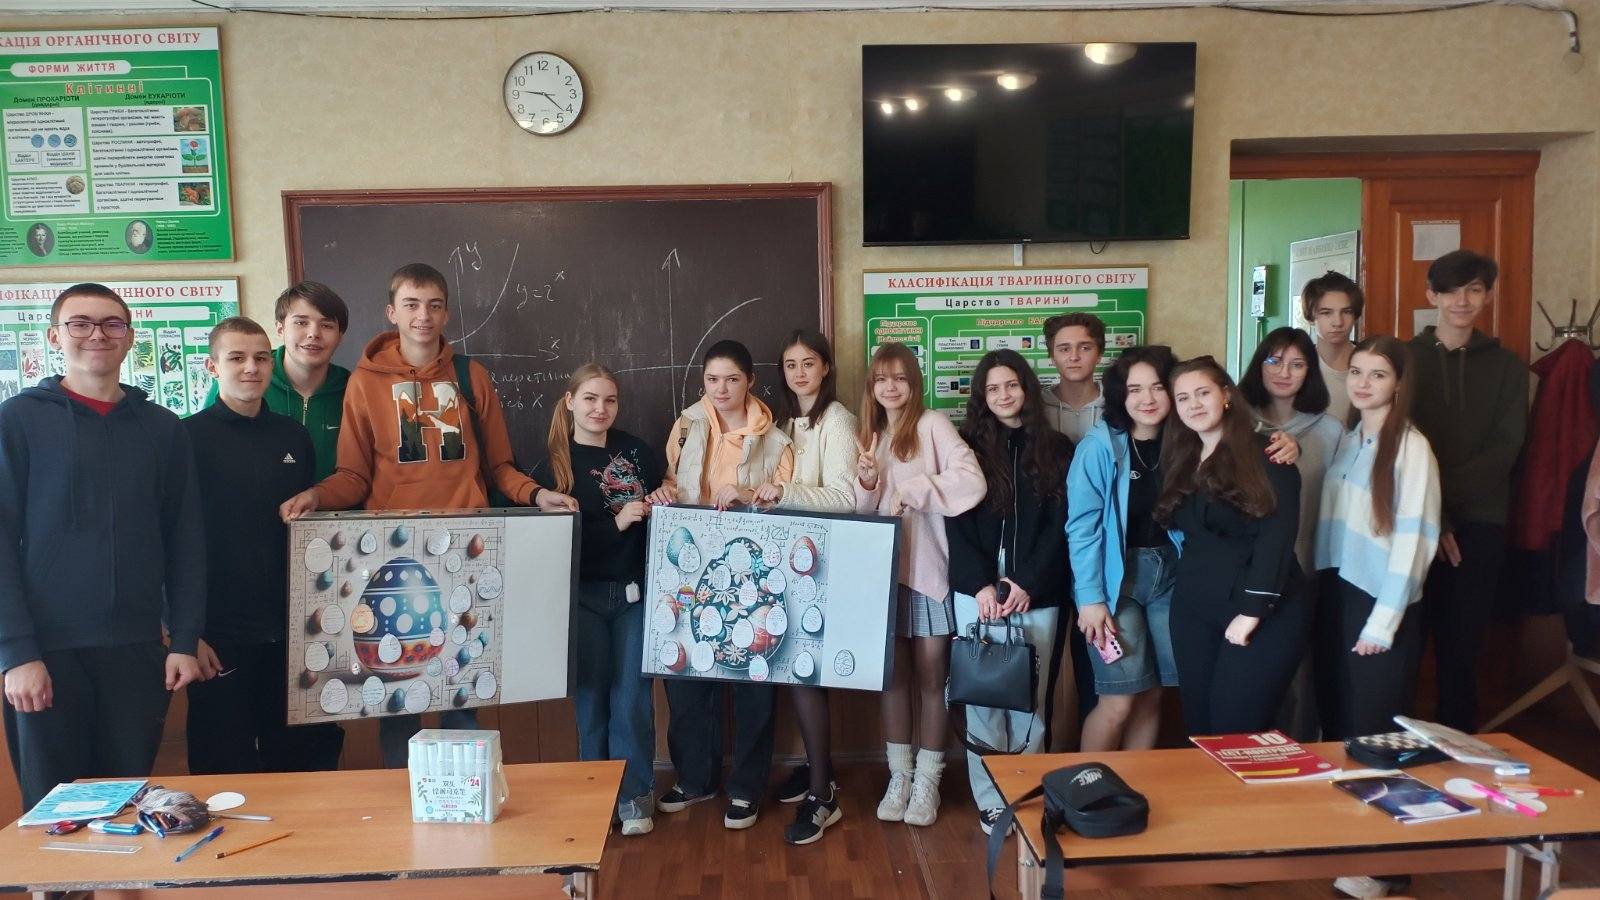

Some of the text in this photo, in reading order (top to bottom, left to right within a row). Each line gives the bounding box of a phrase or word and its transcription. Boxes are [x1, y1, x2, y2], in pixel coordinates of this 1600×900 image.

[46, 33, 153, 47] ОРГАНІЧНОГО
[157, 32, 201, 45] СВІТУ
[28, 62, 116, 73] ФОРМИ ЖИТТЯ
[524, 65, 533, 75] 11
[537, 60, 549, 71] 12
[555, 65, 560, 75] 1
[514, 75, 526, 86] 10
[564, 75, 573, 86] 2
[64, 80, 145, 95] Клітинні
[512, 89, 520, 100] 9
[569, 88, 577, 100] 3
[517, 104, 525, 114] 8
[565, 103, 574, 114] 4
[528, 112, 536, 123] 7
[556, 112, 564, 124] 5
[887, 272, 1137, 289] КЛАСИФІКАЦІЯ ТВАРИННОГО СВІТУ
[112, 286, 176, 299] ИННОГО
[179, 285, 224, 297] СВІТУ
[945, 296, 1070, 309] Царство ТВАРИНИ
[17, 309, 153, 323] Царс НИ
[391, 381, 466, 464] H
[1248, 732, 1288, 746] 10
[469, 778, 480, 787] 24
